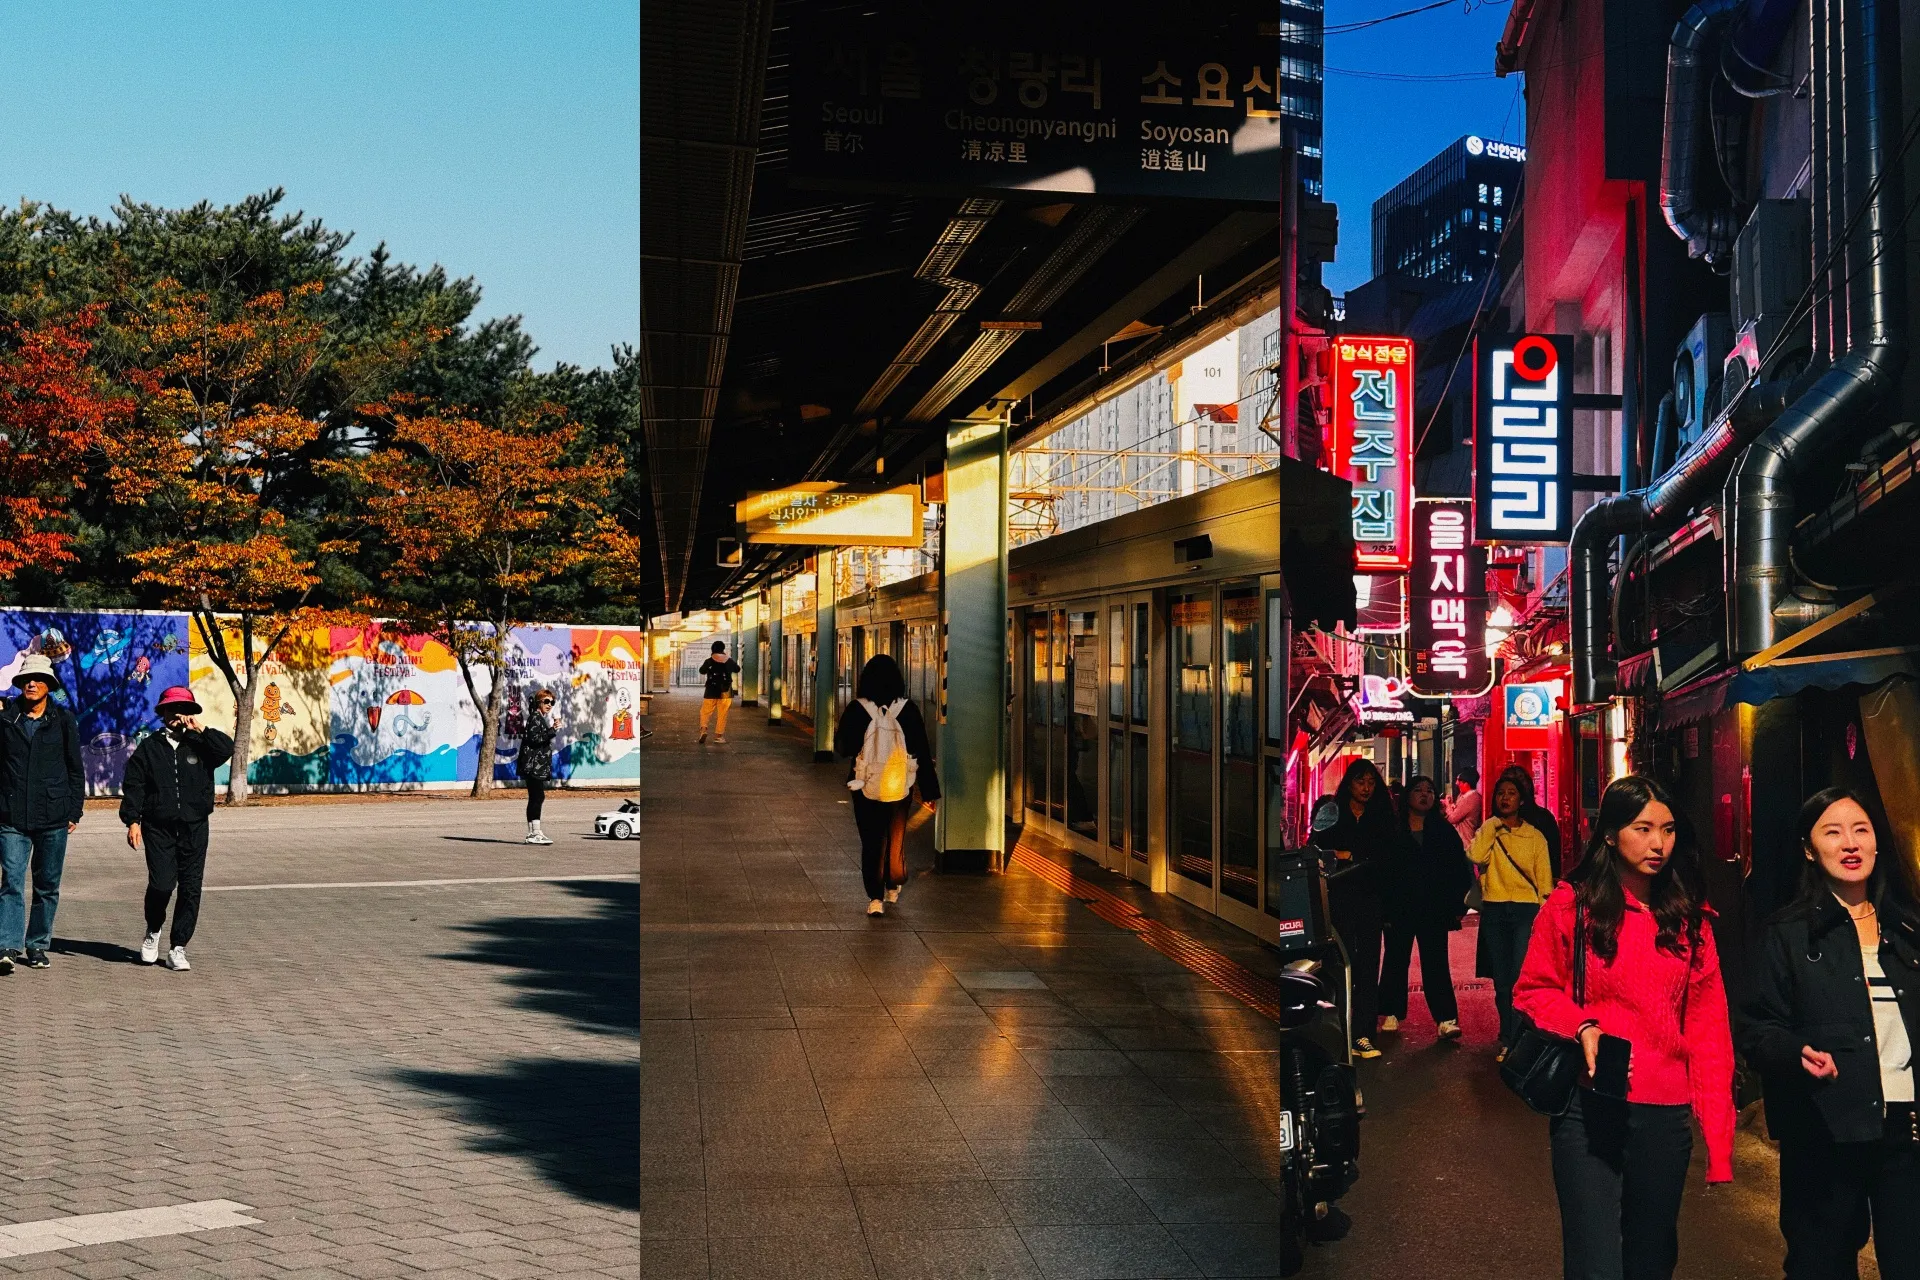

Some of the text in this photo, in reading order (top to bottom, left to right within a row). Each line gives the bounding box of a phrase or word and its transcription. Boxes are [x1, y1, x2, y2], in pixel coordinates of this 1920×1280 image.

[822, 40, 922, 99] 서울
[957, 43, 1102, 110] 청량리
[822, 100, 884, 125] Seoul
[944, 108, 1117, 141] Cheongnyangni
[822, 129, 864, 153] 首尔
[1141, 120, 1230, 147] Soyosan
[1203, 367, 1221, 378] 101
[1349, 369, 1397, 543] 전주집
[1429, 510, 1467, 680] 을지맥옥
[365, 654, 424, 665] GRAND MINT
[374, 666, 417, 677] FESTIVAL
[600, 659, 626, 670] GRAND
